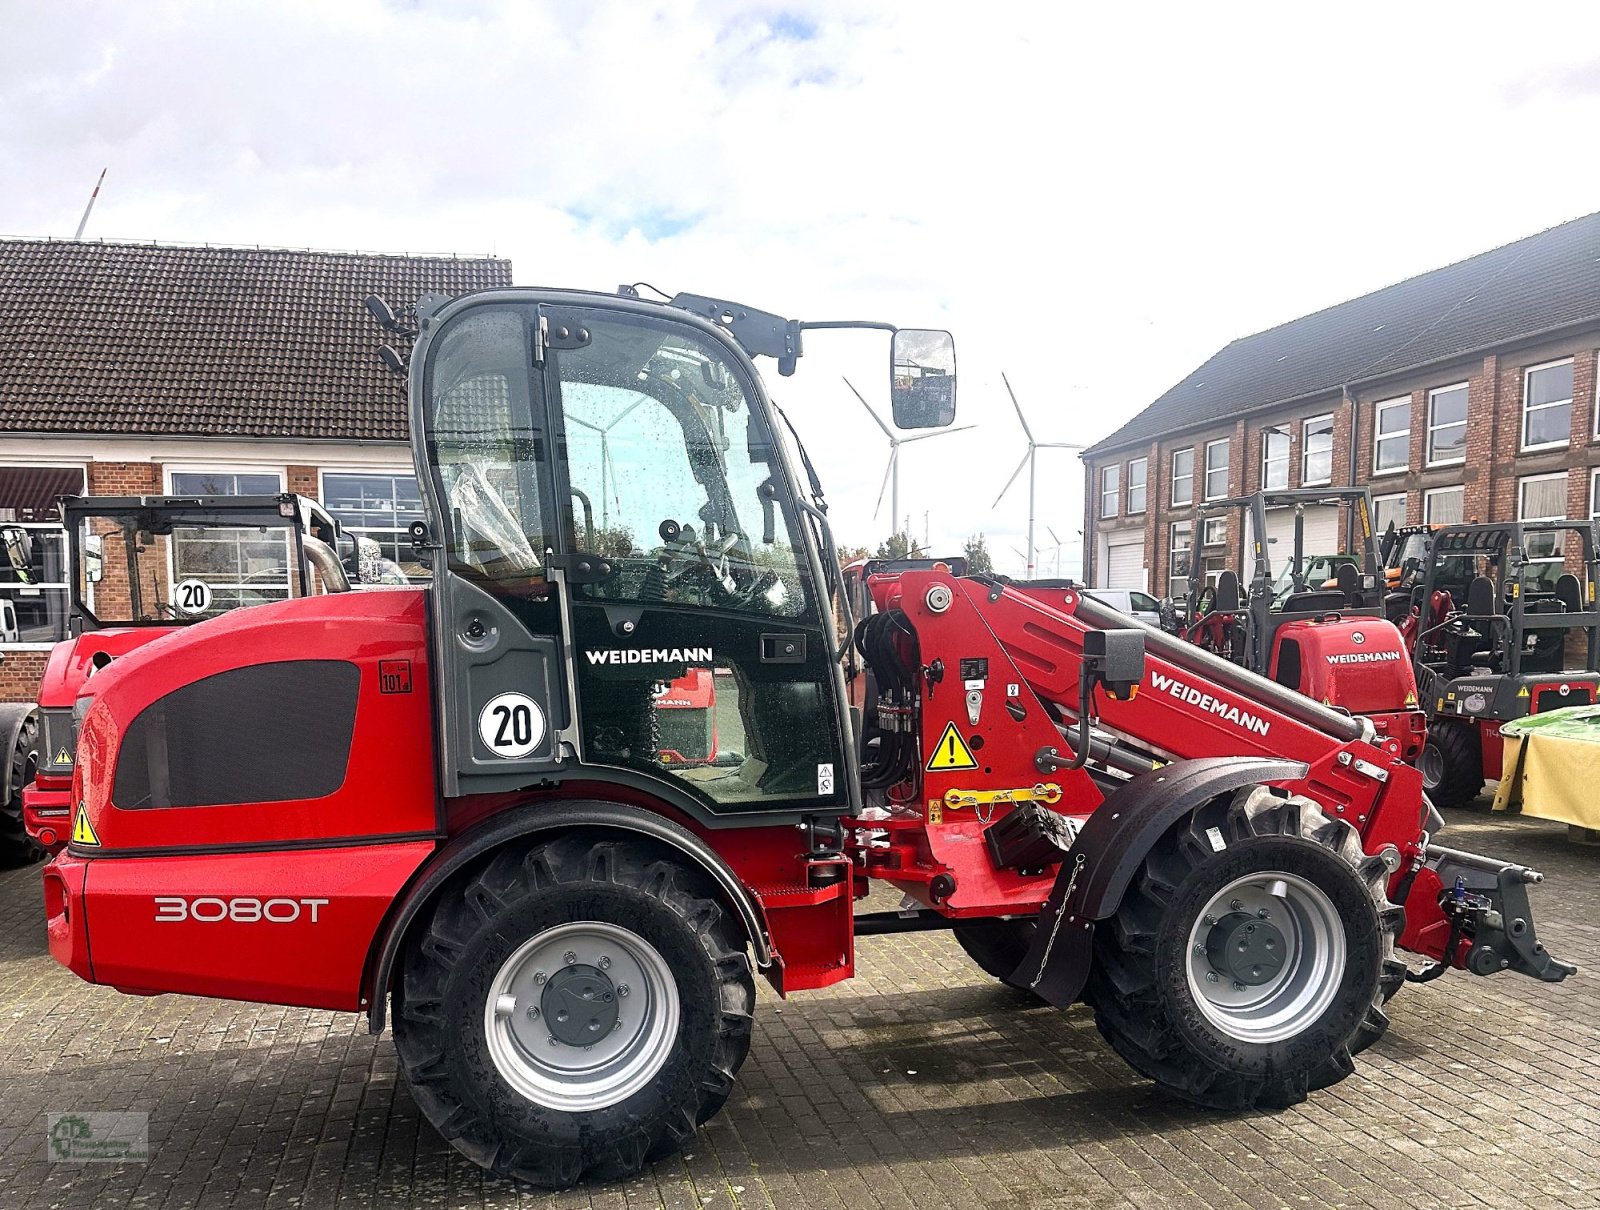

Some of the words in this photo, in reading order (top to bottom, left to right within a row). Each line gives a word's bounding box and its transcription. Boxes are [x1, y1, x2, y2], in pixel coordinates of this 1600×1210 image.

[182, 585, 205, 608] 20
[585, 648, 713, 665] WEIDEMANN
[1326, 651, 1401, 664] WEIDEMANN
[383, 674, 401, 691] 101
[1457, 685, 1494, 693] WEIDEMANN
[1151, 671, 1271, 737] WEIDEMANN
[492, 704, 532, 747] 20
[154, 897, 329, 923] 3080T
